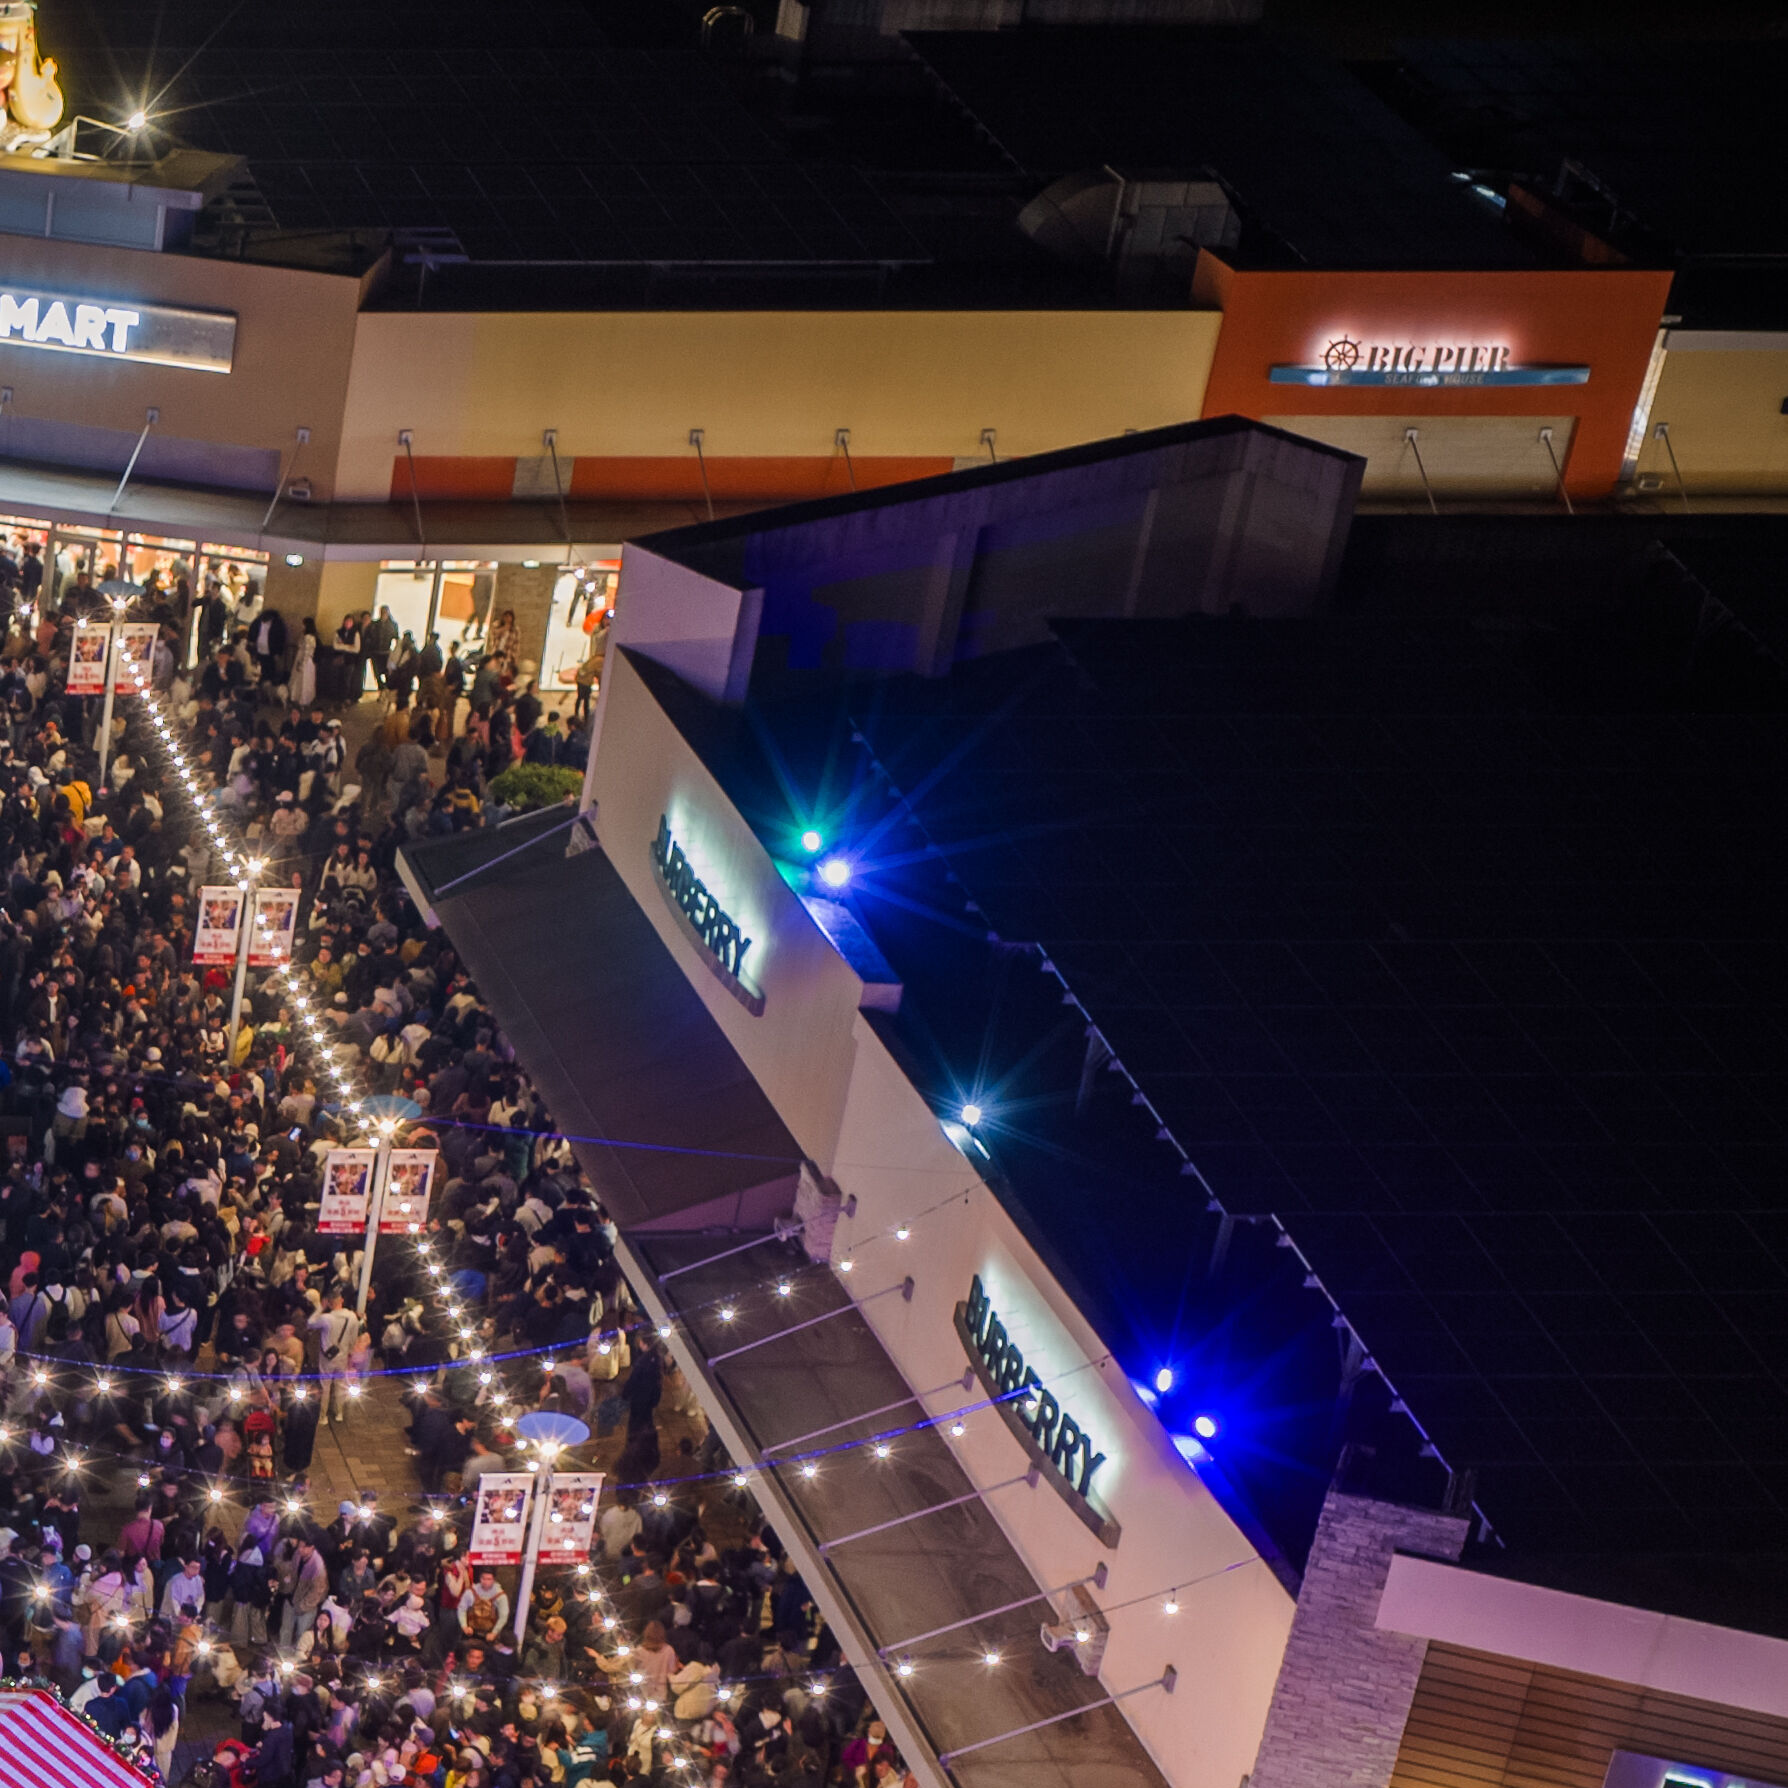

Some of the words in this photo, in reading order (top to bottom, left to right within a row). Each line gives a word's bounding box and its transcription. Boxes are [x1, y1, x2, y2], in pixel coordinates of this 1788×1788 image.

[1366, 345, 1425, 373] BIG
[1431, 345, 1511, 373] PIER
[965, 1273, 1107, 1498] BURBERRY
